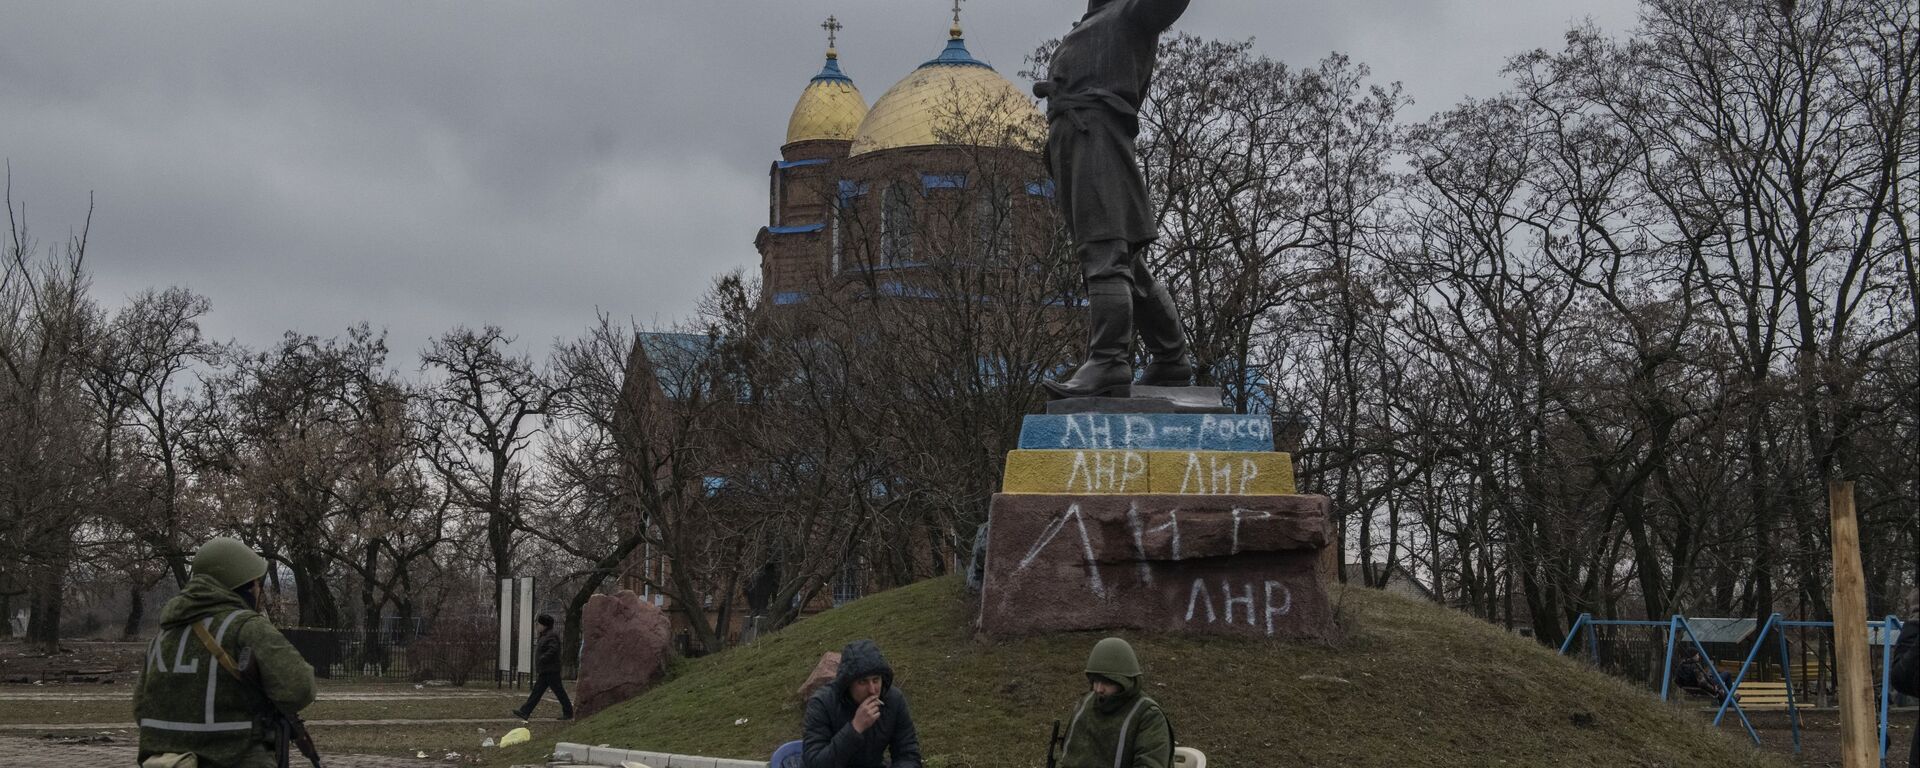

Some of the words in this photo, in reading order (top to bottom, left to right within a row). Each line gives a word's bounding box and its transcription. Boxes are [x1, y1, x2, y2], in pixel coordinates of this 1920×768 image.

[1061, 414, 1154, 449] ЛНР
[1067, 451, 1146, 492] ЛНР
[1180, 452, 1258, 495] ЛНР
[1185, 577, 1291, 636] ЛНР
